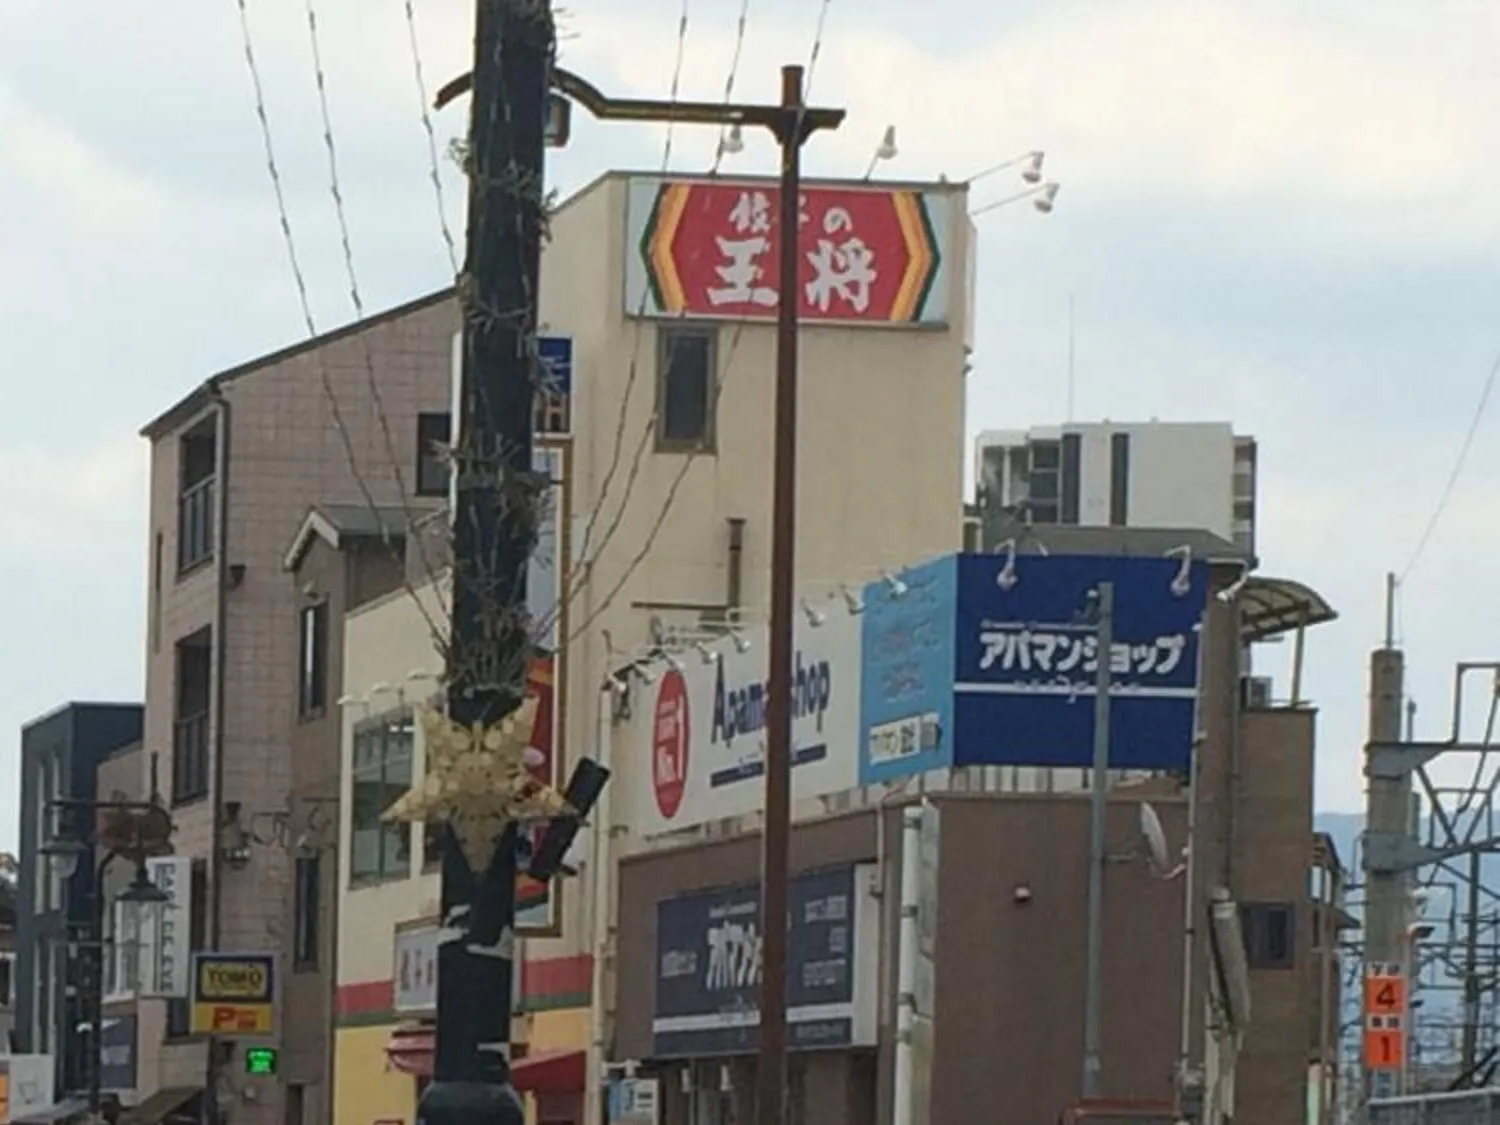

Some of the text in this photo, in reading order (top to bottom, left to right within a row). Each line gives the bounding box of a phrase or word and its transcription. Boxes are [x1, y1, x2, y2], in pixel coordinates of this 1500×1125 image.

[706, 235, 877, 313] 王将
[978, 630, 1185, 674] アパマンショップ
[1375, 983, 1396, 1008] 4
[1380, 1035, 1391, 1062] 1
